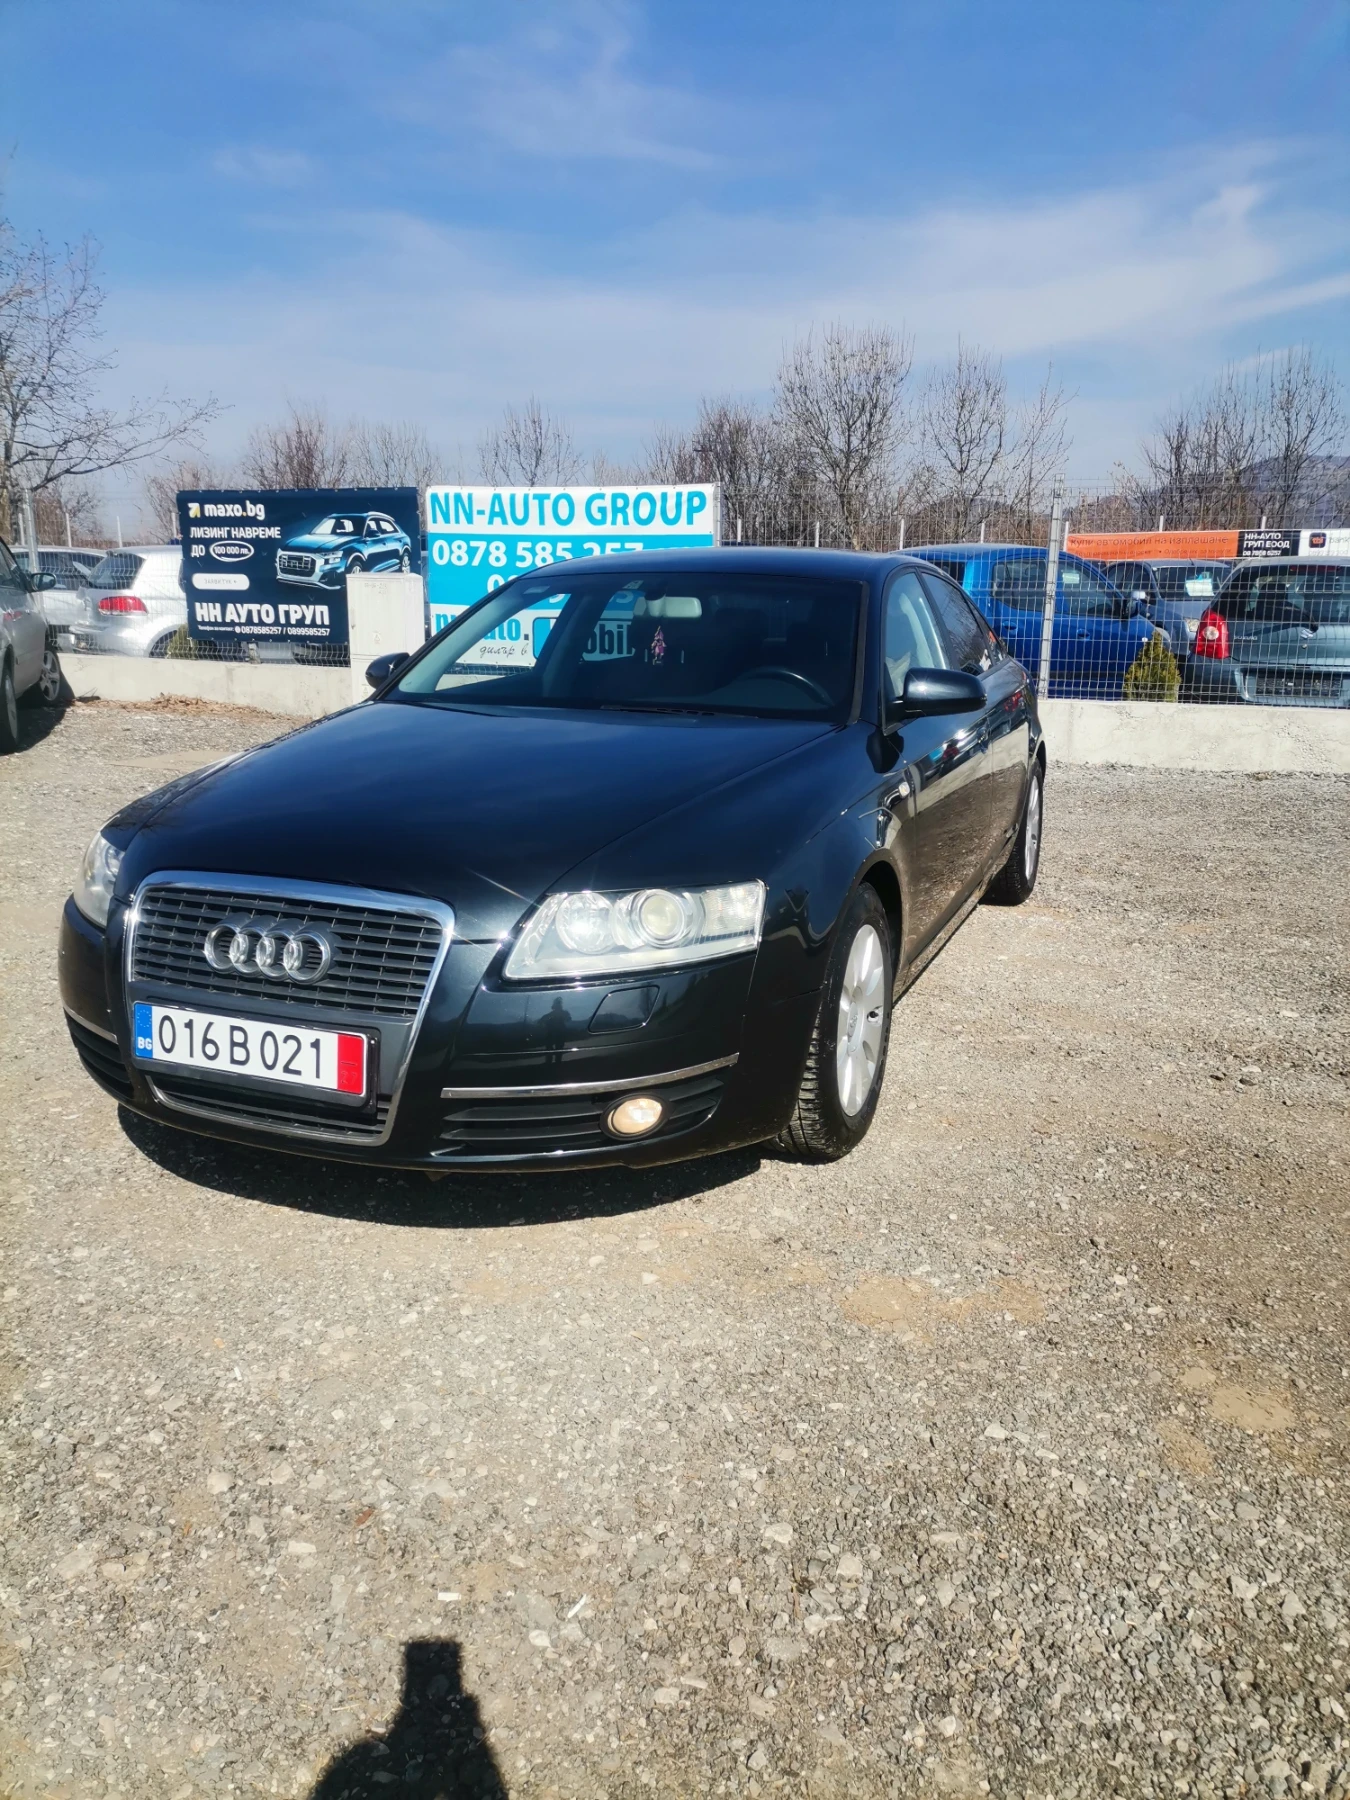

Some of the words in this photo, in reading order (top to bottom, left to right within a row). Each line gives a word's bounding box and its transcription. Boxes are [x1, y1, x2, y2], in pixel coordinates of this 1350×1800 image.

[204, 500, 265, 520] maxo.bg
[430, 492, 575, 526] NN-AUTO
[585, 491, 707, 526] GROUP
[190, 527, 230, 538] ЛИЗИНГ
[231, 527, 281, 539] НАВРЕМЕ
[1244, 532, 1281, 540] НН-АУТО
[191, 545, 206, 557] ДО
[214, 546, 225, 554] 100
[226, 546, 239, 554] 000
[432, 539, 507, 567] 0878
[515, 541, 572, 568] 585
[195, 602, 222, 622] НН
[225, 603, 275, 624] АУТО
[278, 604, 330, 625] ГРУП
[242, 626, 281, 634] 0878585257
[288, 628, 330, 636] 0899585257
[480, 646, 515, 658] дилър
[137, 1036, 152, 1050] BG
